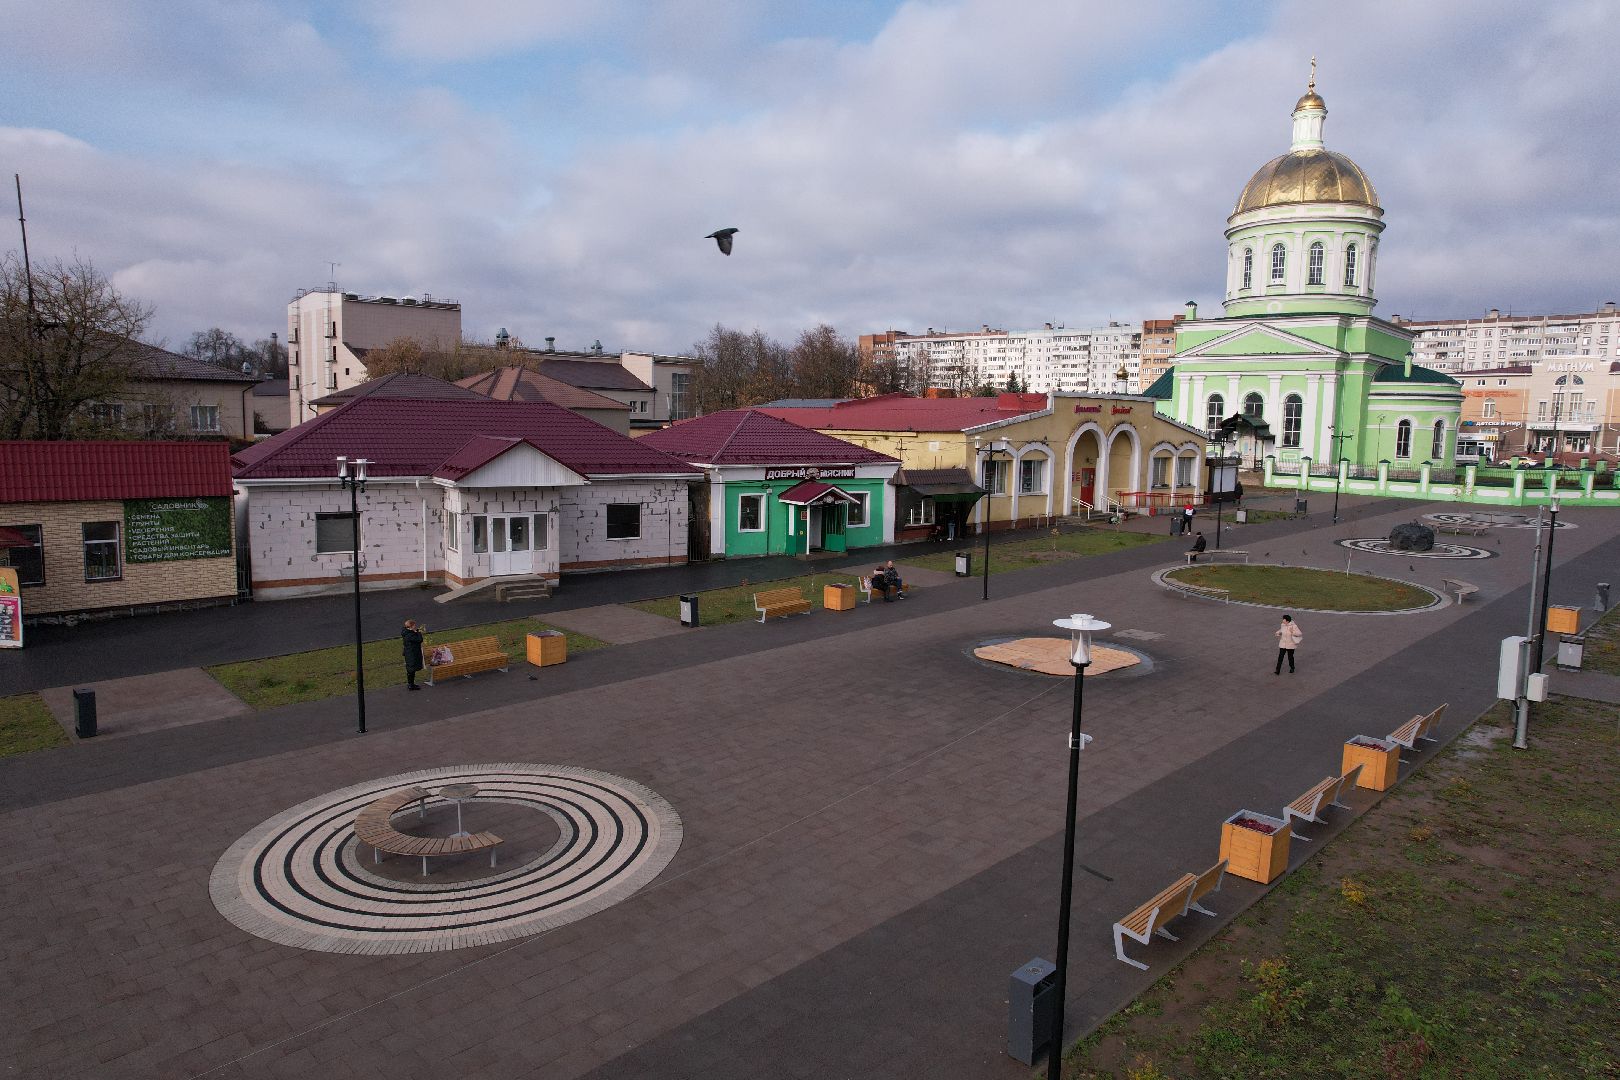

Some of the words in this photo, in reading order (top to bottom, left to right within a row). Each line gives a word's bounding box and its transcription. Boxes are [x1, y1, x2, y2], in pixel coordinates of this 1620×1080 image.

[1547, 361, 1594, 372] МАГНУМ
[766, 468, 806, 479] ДОБРЫЙ
[820, 469, 855, 478] МЯСНИК
[151, 502, 197, 510] САДОВНИК
[132, 539, 170, 547] РАСТЕНИЙ
[133, 546, 168, 554] САДОВЫЙ
